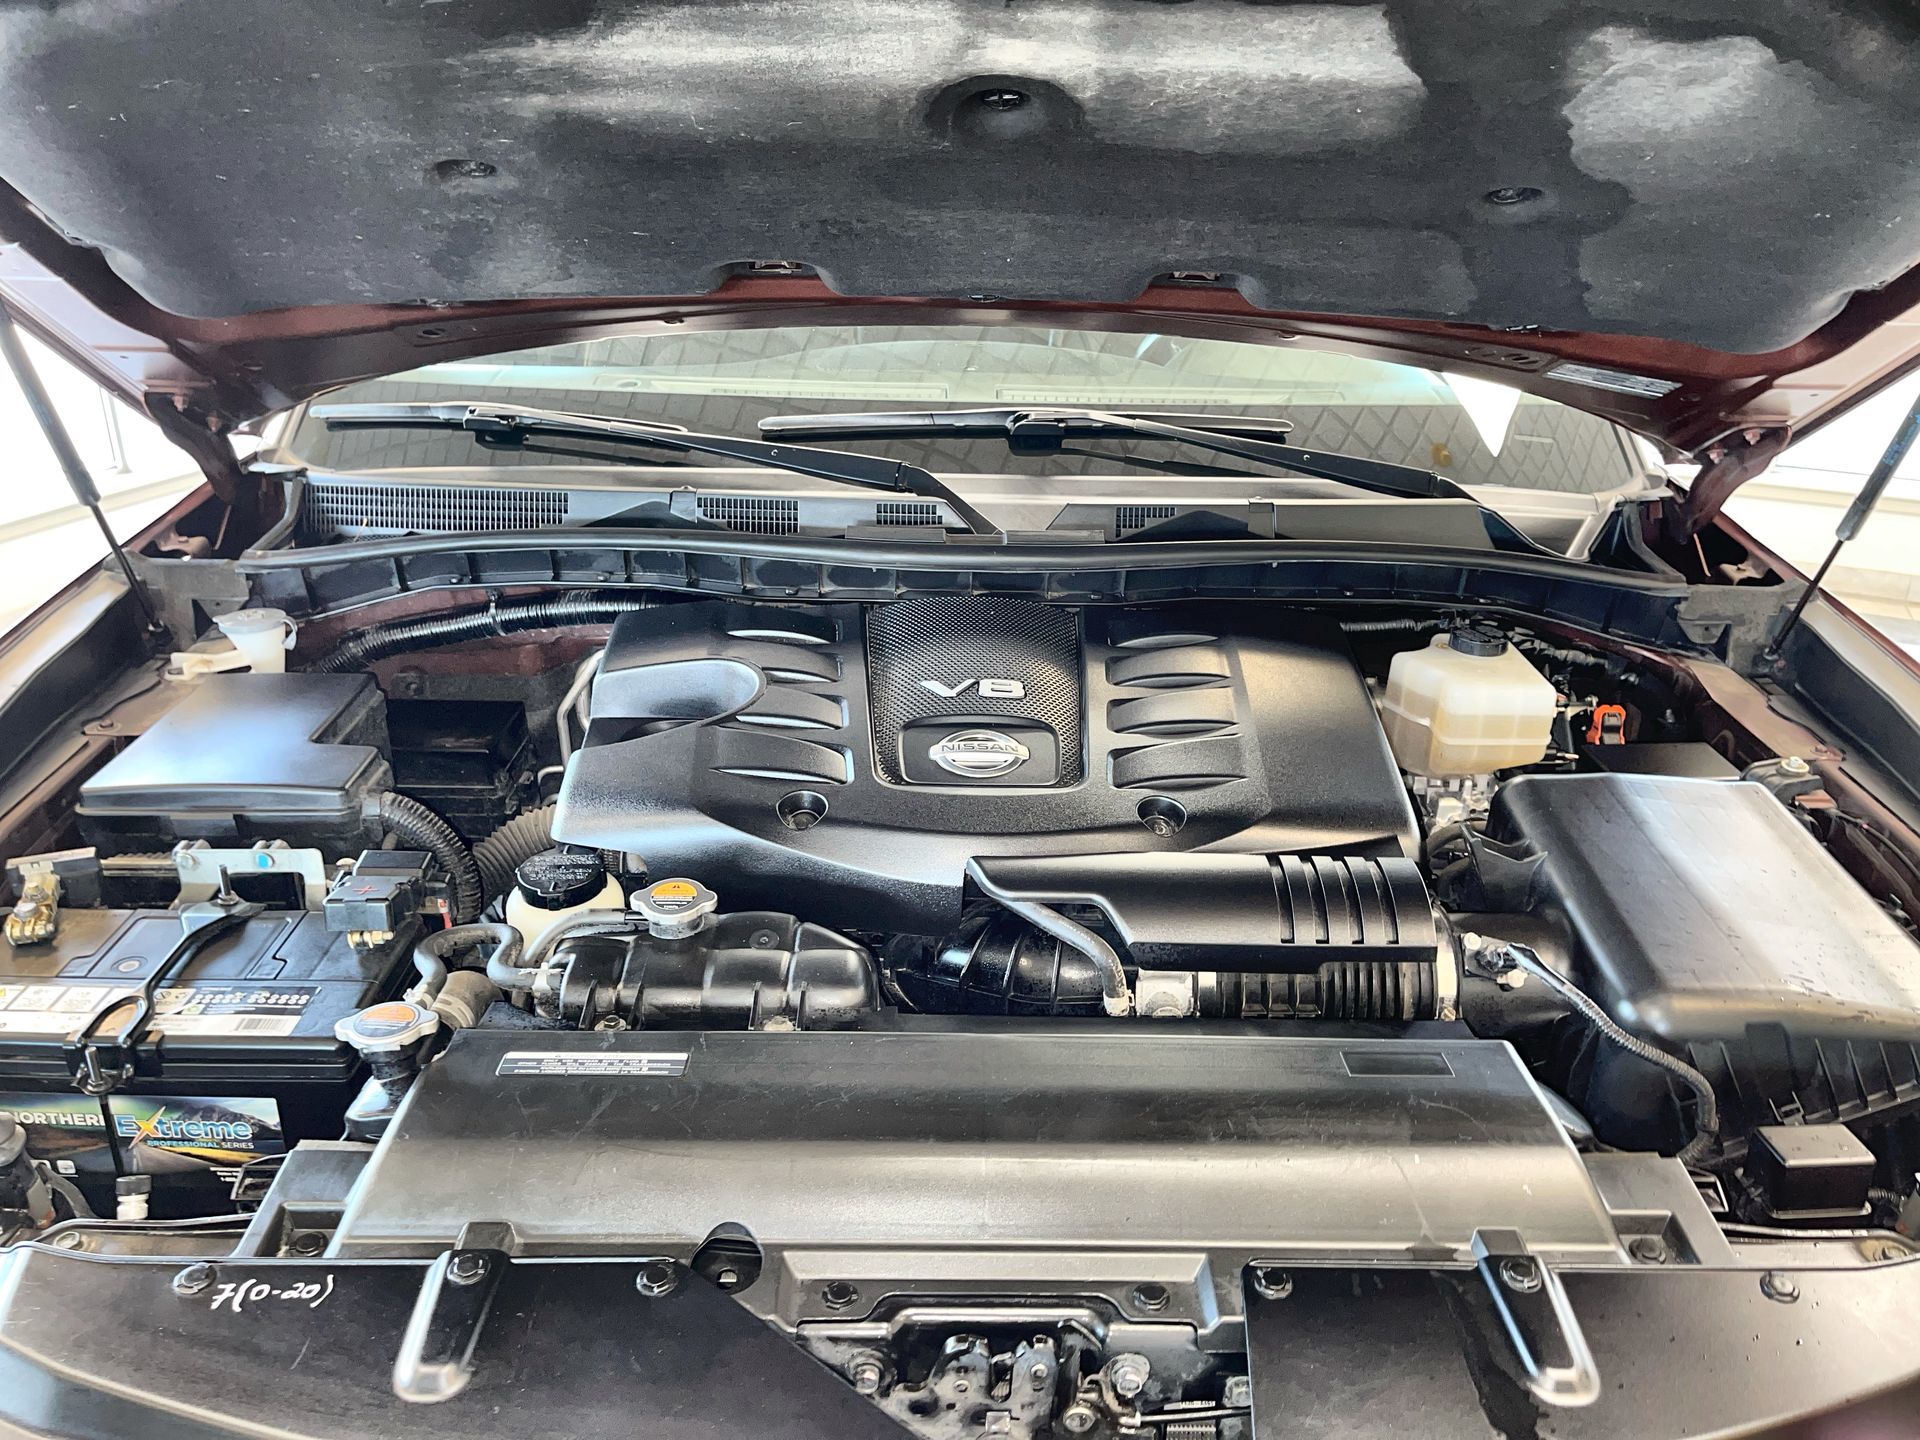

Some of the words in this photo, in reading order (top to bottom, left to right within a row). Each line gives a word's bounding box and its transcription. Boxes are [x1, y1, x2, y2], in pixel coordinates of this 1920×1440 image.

[919, 678, 1025, 698] V8
[942, 741, 1018, 753] NISSAN
[146, 1139, 220, 1149] PROFESSIONAL
[222, 1141, 254, 1150] SERIES
